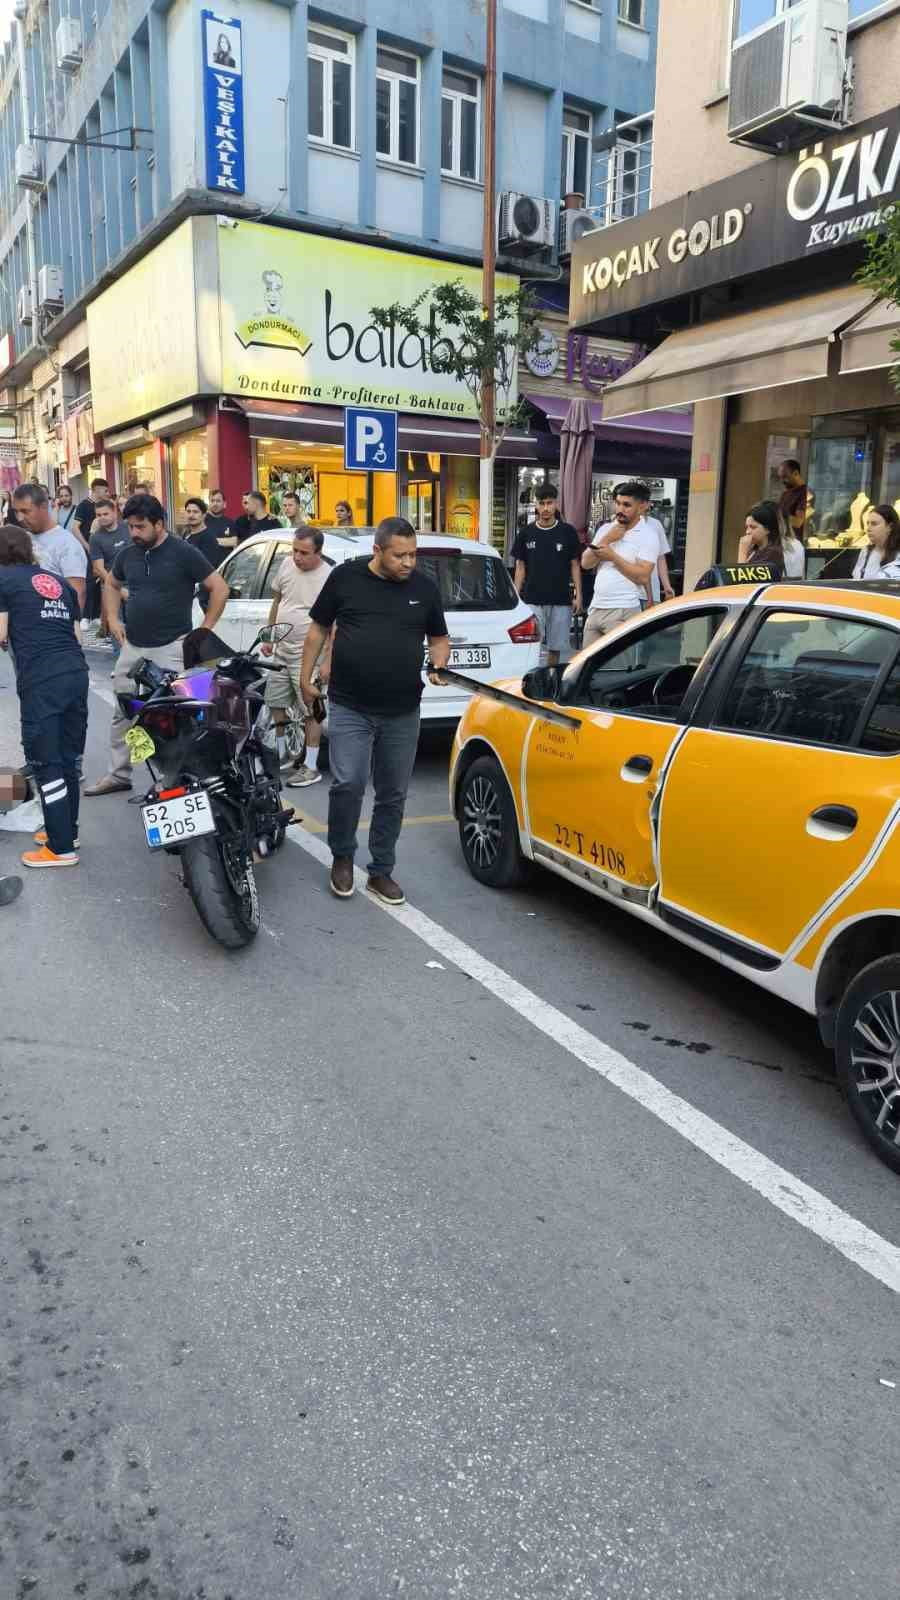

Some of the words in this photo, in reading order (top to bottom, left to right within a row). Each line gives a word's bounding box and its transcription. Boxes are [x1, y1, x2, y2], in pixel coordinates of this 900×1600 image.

[582, 237, 661, 295] KOÇAK
[667, 208, 744, 263] GOLD
[238, 375, 322, 397] Dondurma
[356, 416, 383, 463] P
[466, 650, 488, 663] 338
[146, 805, 168, 823] 52
[184, 796, 207, 813] SE
[163, 817, 196, 838] 205
[555, 823, 571, 848] 22
[573, 830, 584, 855] T
[590, 840, 626, 875] 4108
